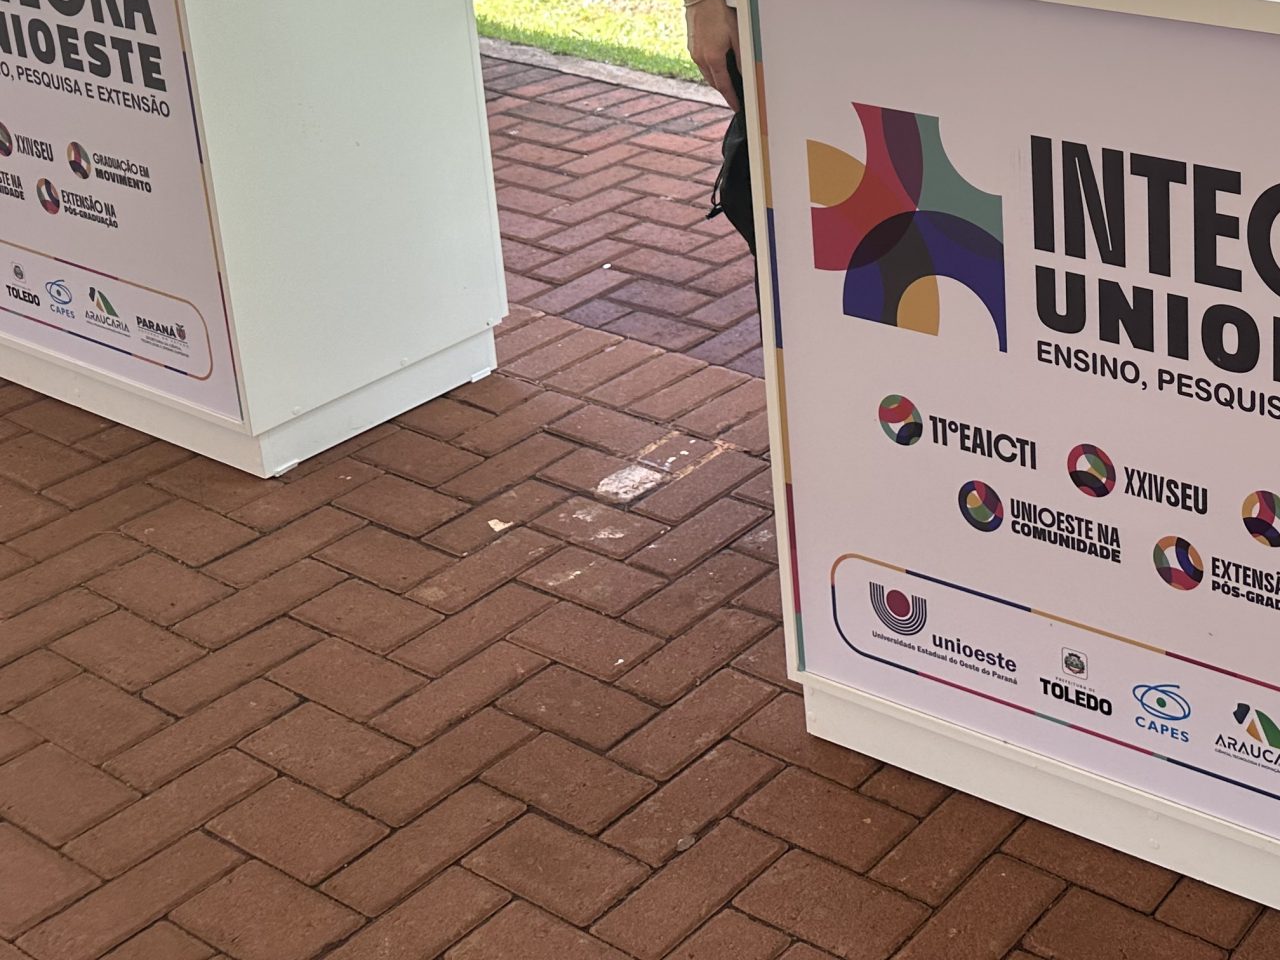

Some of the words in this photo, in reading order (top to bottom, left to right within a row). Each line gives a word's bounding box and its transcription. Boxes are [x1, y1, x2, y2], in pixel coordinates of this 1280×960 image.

[16, 65, 82, 96] PESQUISA
[85, 83, 95, 99] E
[97, 85, 170, 119] EXTENSÃO
[92, 152, 138, 175] GRADUAÇÃO
[139, 165, 150, 178] EM
[10, 173, 23, 190] NA
[95, 167, 152, 193] MOVIMENTO
[61, 189, 103, 214] EXTENSÃO
[104, 202, 117, 219] NA
[6, 285, 40, 307] TOLEDO
[50, 304, 75, 319] CAPES
[85, 310, 130, 332] ARAUCARIA
[136, 316, 176, 337] PARANÁ
[1037, 340, 1148, 390] ENSINO,
[1010, 498, 1093, 541] UNIOESTE
[1097, 521, 1122, 549] NA
[1011, 520, 1122, 564] COMUNIDADE
[872, 630, 916, 651] Universidade
[917, 645, 948, 662] Estadual
[959, 660, 980, 673] Oeste
[981, 666, 991, 676] do
[992, 670, 1018, 685] Paraná
[932, 633, 1017, 673] unioeste
[1040, 677, 1112, 716] TOLEDO
[1135, 716, 1189, 743] CAPES
